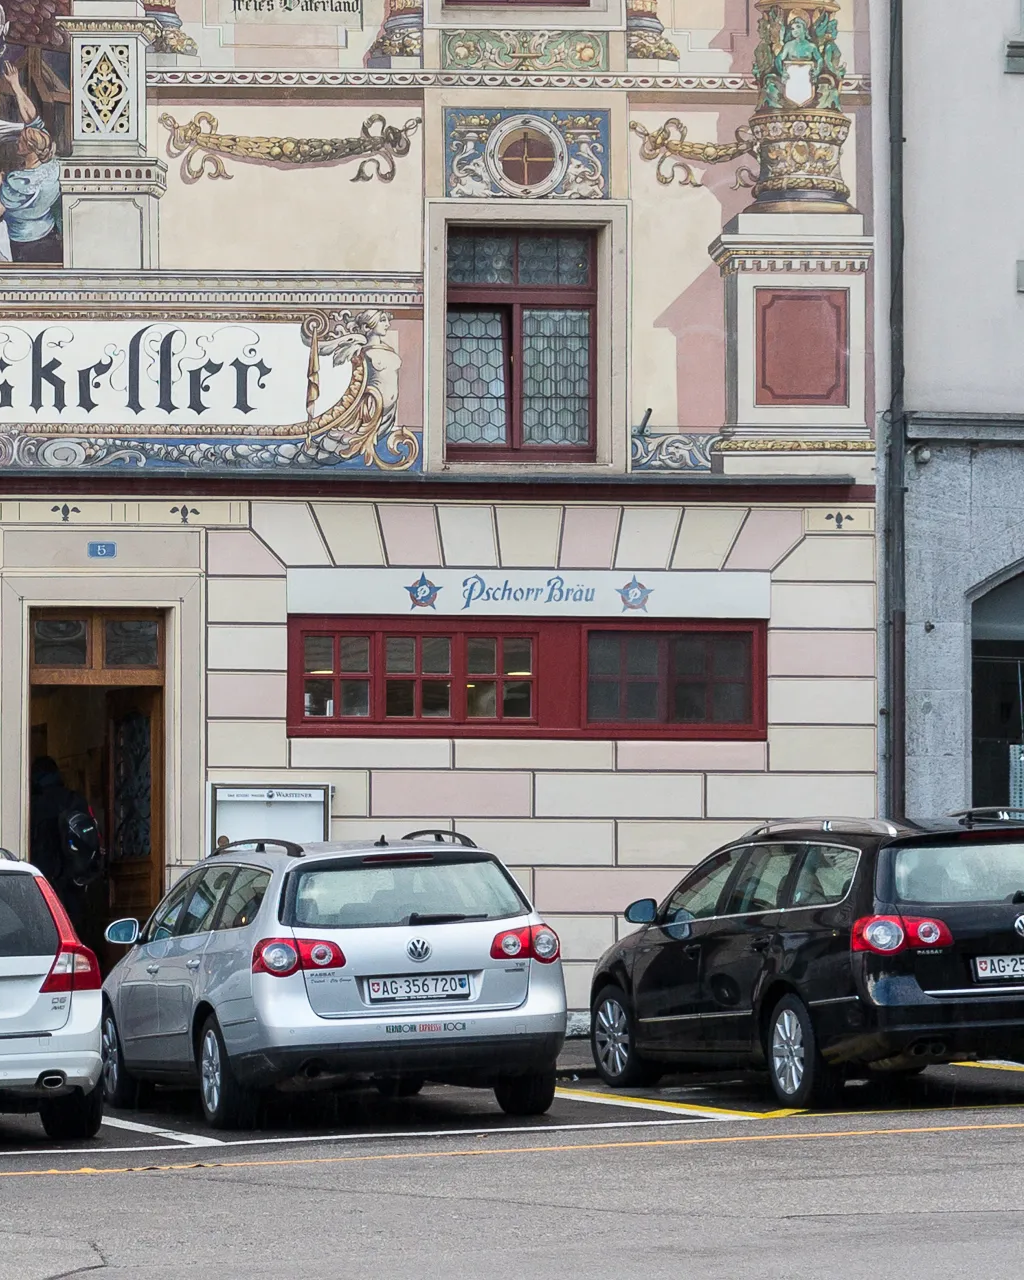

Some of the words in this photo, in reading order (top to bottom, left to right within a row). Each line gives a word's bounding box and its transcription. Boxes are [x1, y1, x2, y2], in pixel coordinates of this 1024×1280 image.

[97, 545, 106, 556] 5
[461, 573, 544, 611] Pschorr
[544, 575, 595, 603] Bräu
